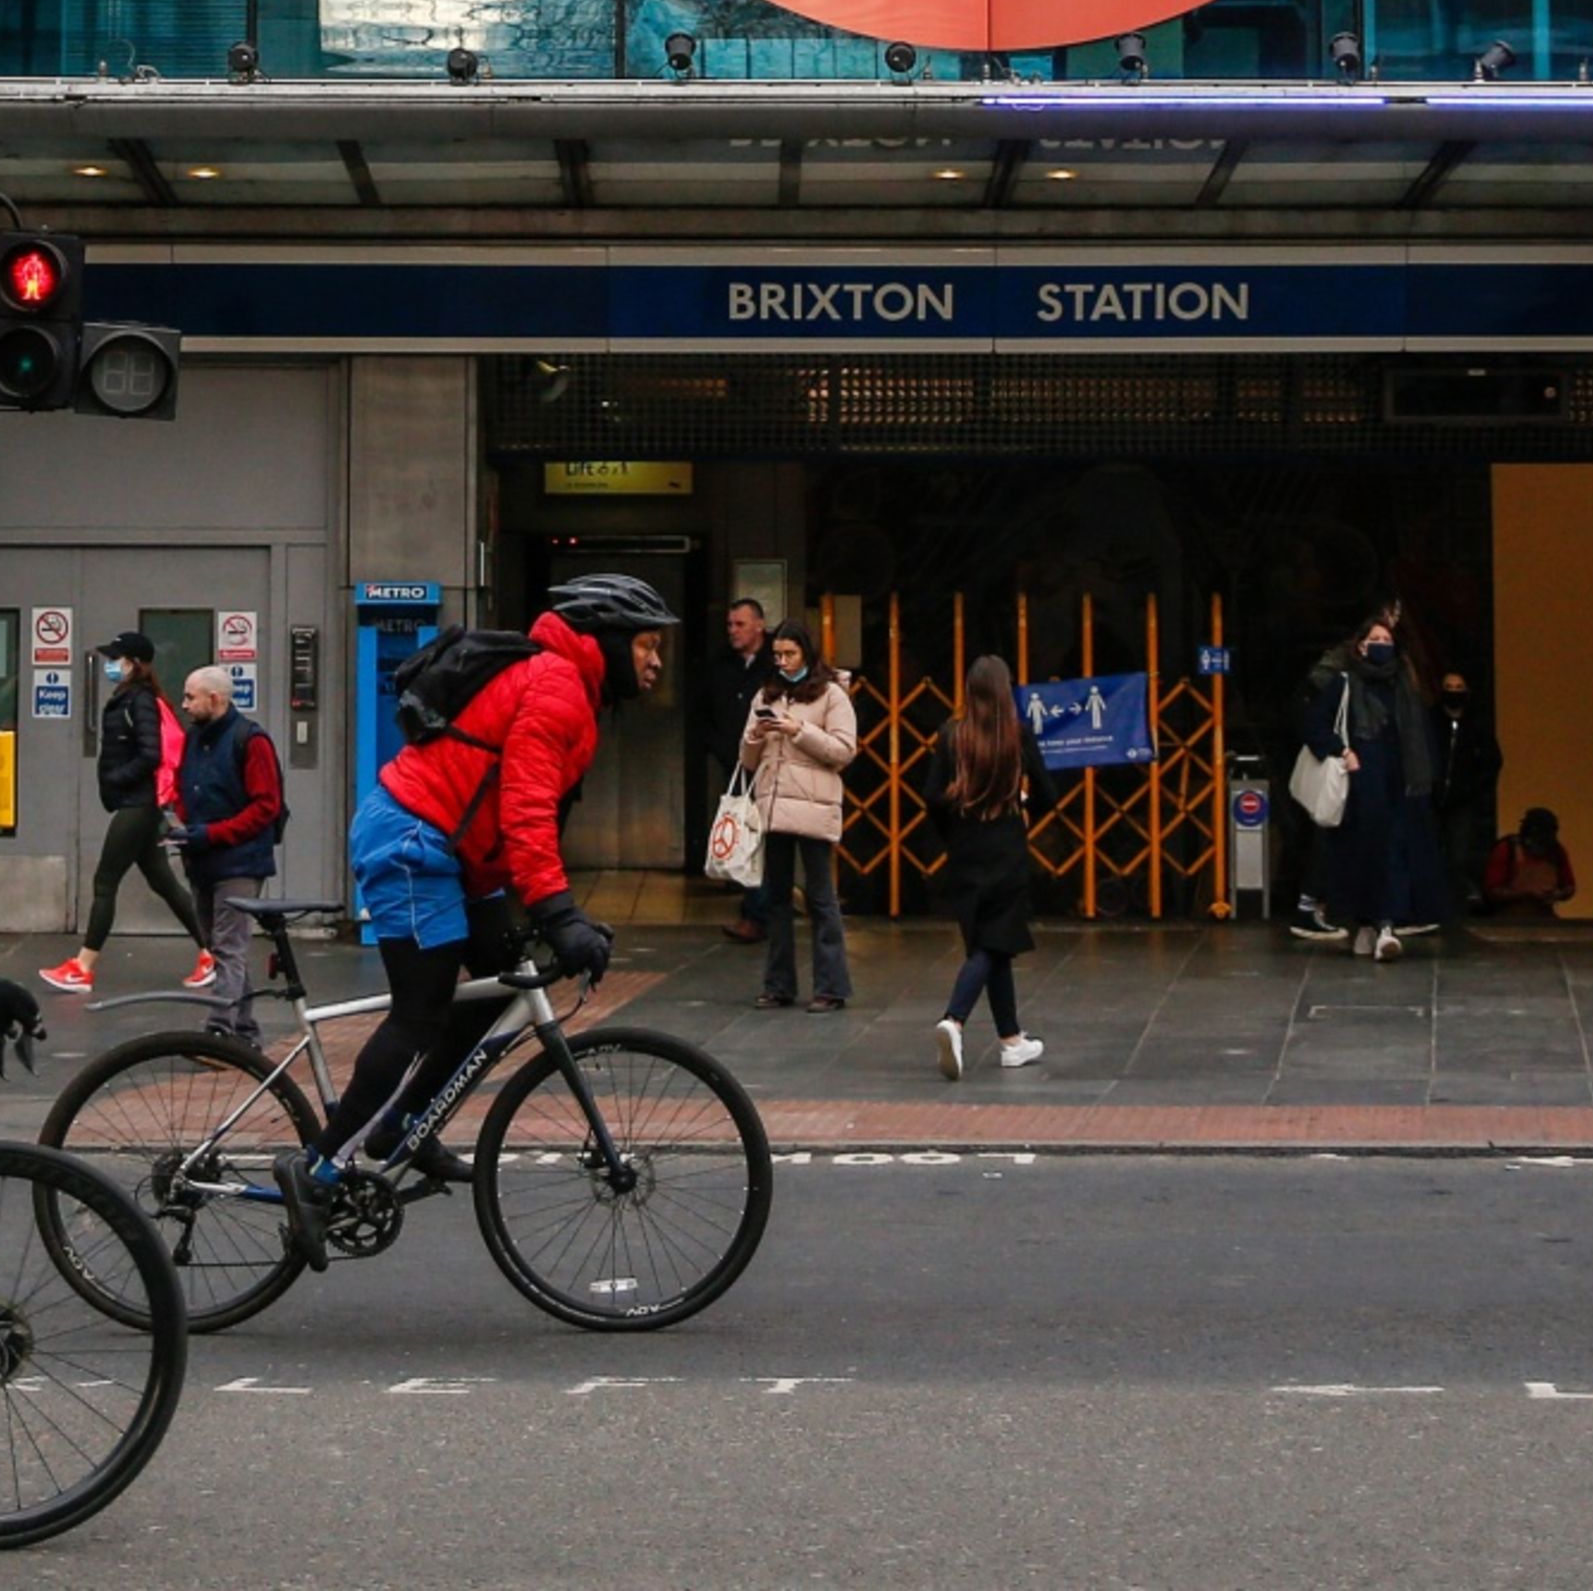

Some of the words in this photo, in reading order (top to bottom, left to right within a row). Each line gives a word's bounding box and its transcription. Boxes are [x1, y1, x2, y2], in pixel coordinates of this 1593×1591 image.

[728, 282, 954, 322] BRIXTON
[1037, 281, 1249, 323] STATION
[367, 585, 425, 599] METRO
[38, 688, 66, 702] Keep
[407, 1048, 488, 1151] BOARDMAN
